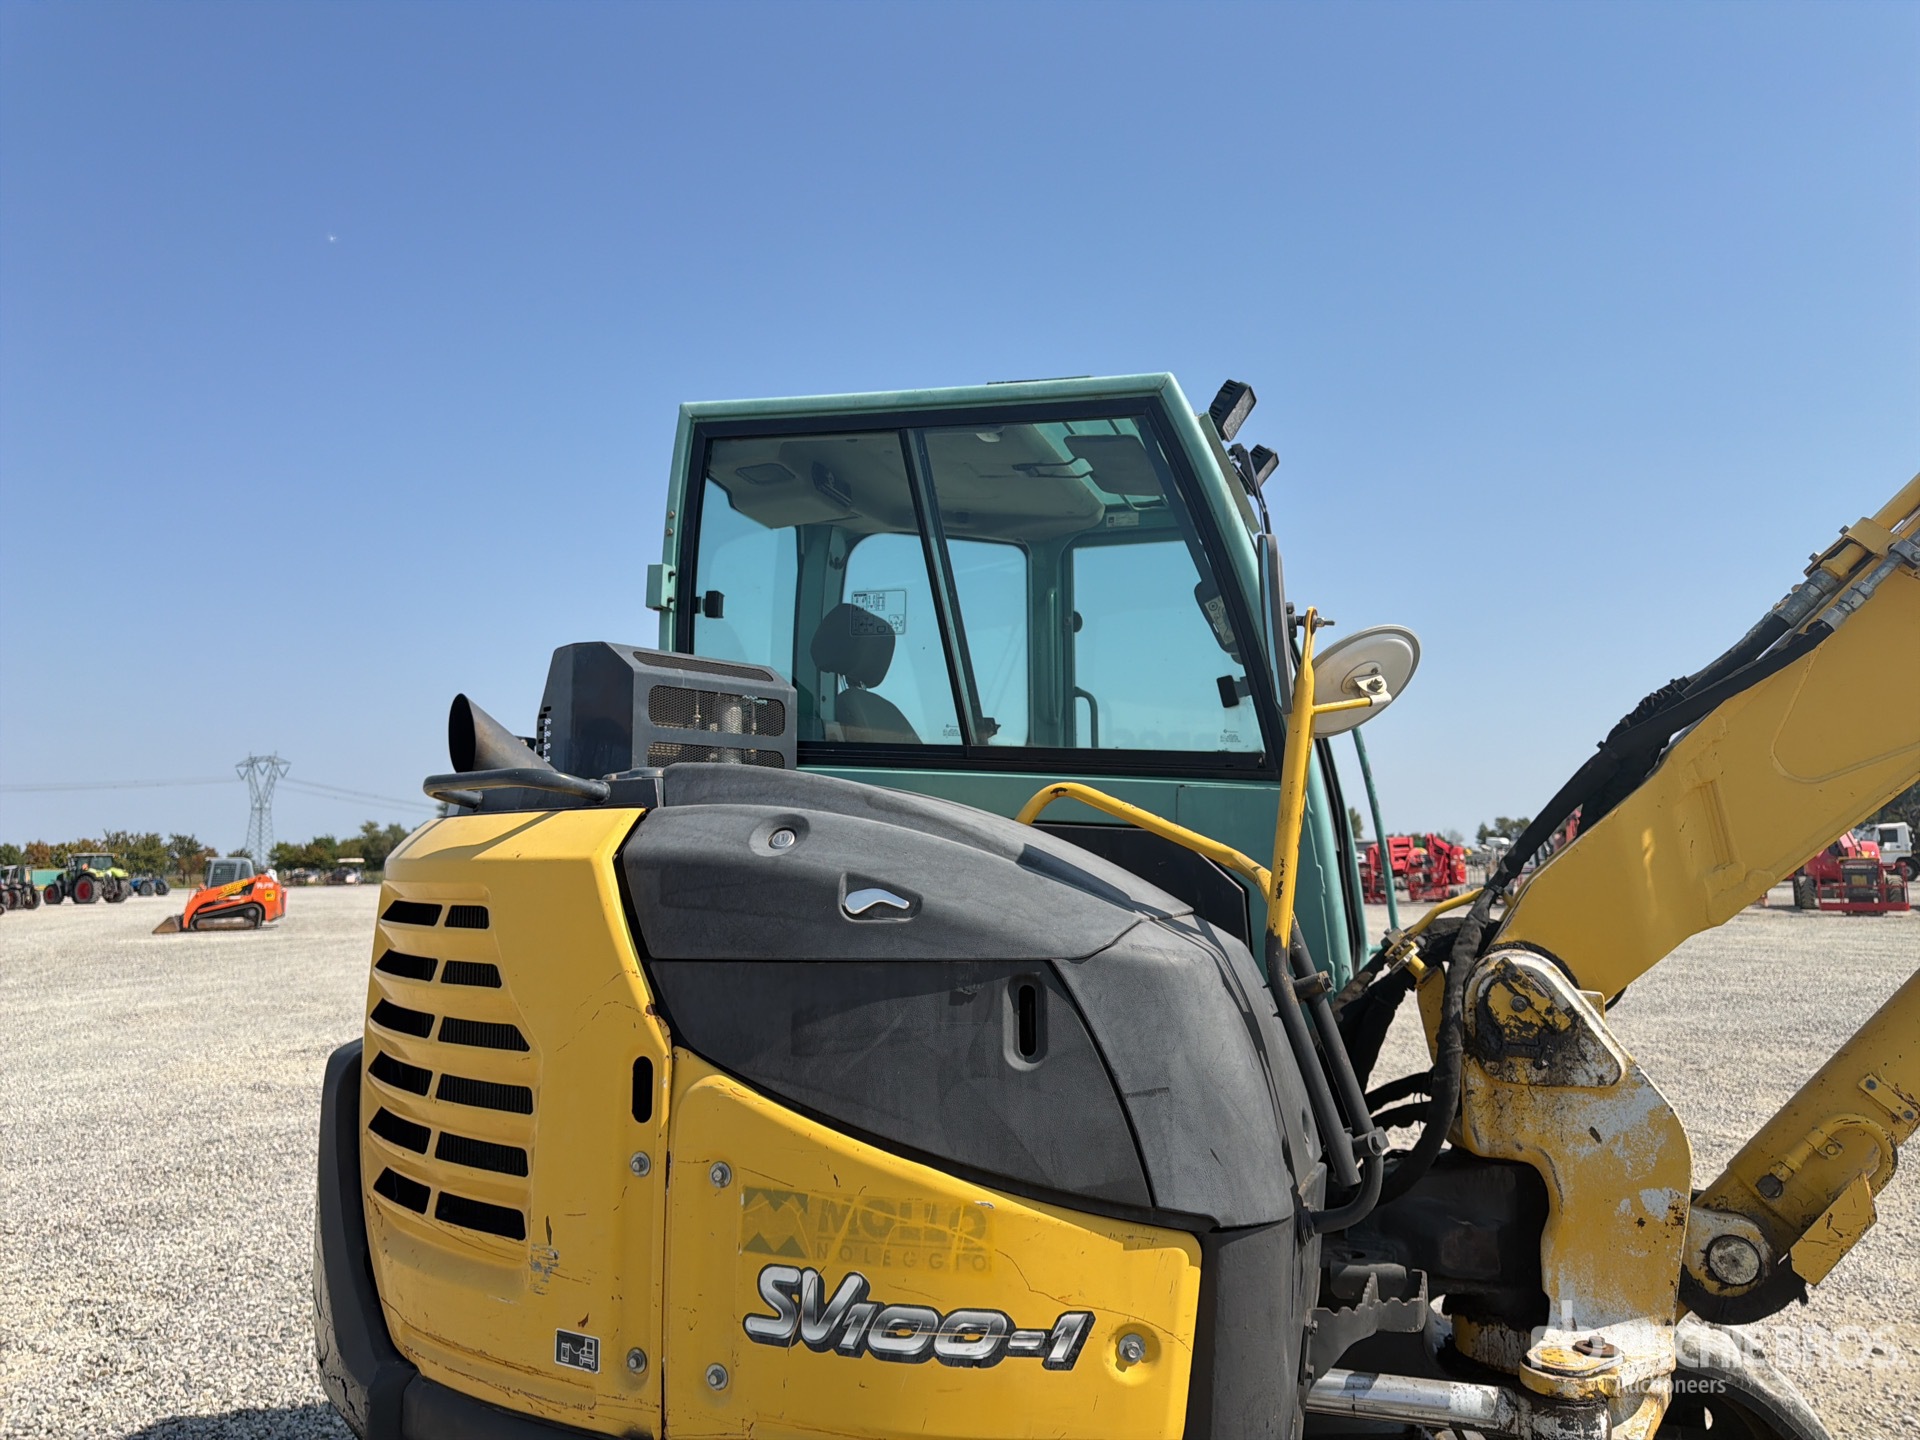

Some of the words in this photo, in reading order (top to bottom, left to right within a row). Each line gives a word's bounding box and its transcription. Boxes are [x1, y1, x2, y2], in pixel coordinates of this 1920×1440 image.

[816, 1198, 988, 1244] MOLLO
[816, 1242, 988, 1272] NOLEGGIO
[743, 1263, 1096, 1371] SV100-1
